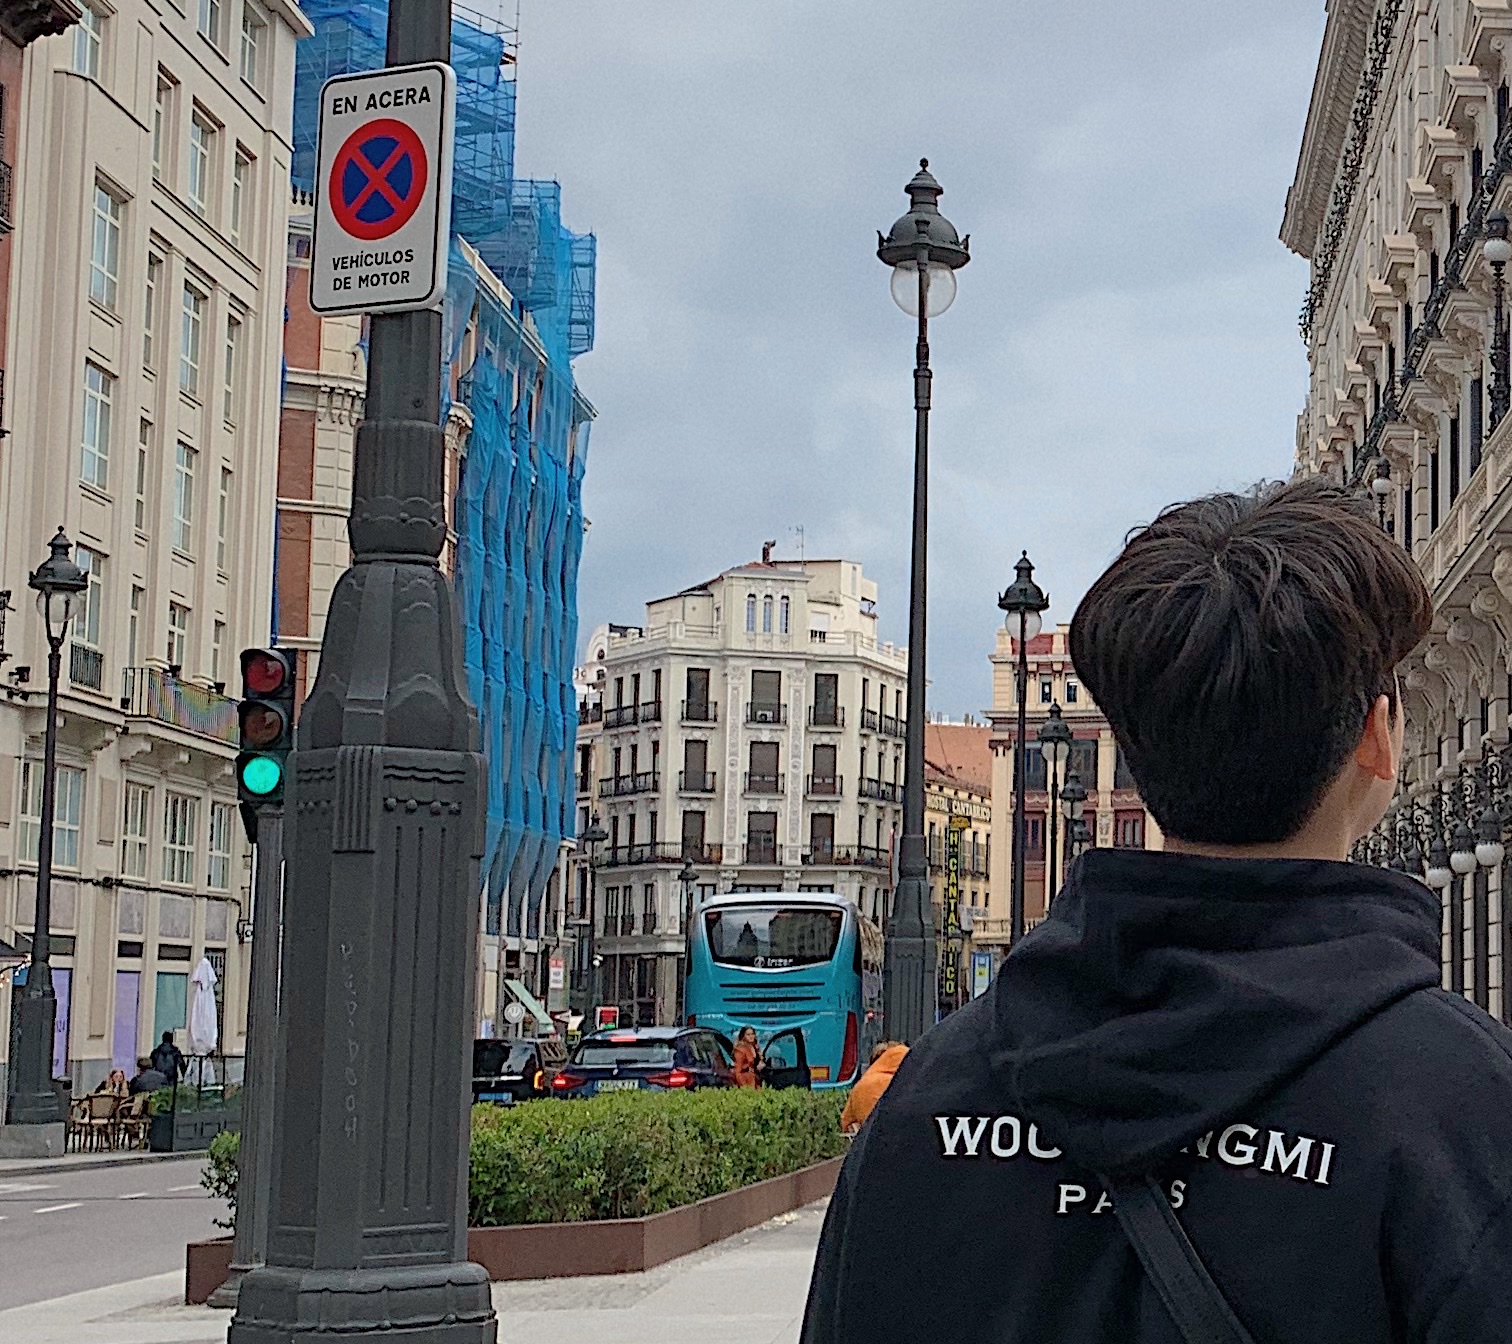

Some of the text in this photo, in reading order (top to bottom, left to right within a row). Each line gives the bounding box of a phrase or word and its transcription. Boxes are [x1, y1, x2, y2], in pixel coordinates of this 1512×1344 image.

[332, 86, 431, 115] EN ACERA
[332, 249, 414, 270] VEHÍCULOS
[332, 270, 410, 291] DE MOTOR
[1056, 1179, 1188, 1214] PAS
